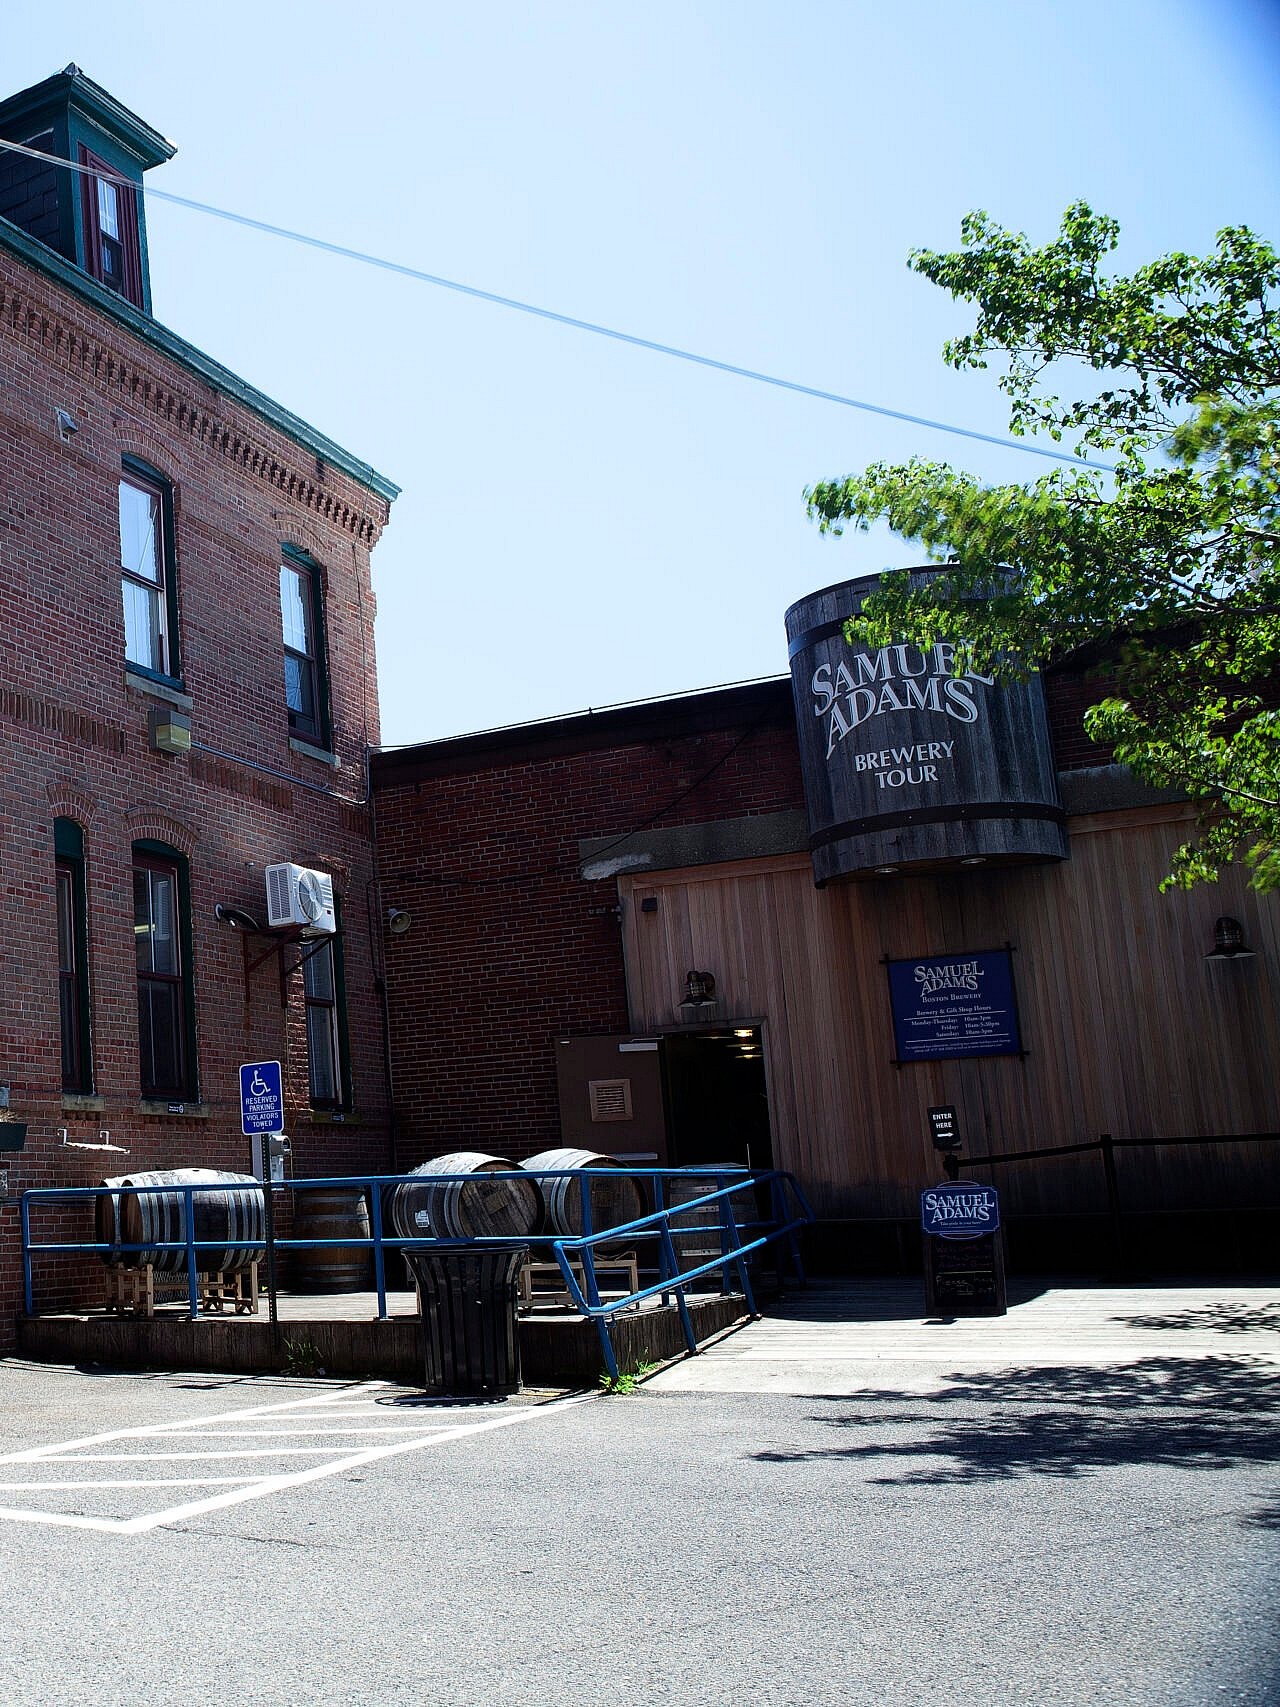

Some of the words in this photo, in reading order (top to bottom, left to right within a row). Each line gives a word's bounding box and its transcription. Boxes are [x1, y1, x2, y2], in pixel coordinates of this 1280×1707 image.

[825, 676, 979, 761] ADAMS
[855, 740, 955, 772] BREWERY
[875, 764, 938, 789] TOUR
[914, 961, 985, 982] SAMUEL
[920, 975, 978, 997] ADAMS
[245, 1095, 278, 1105] RESERVED
[249, 1103, 275, 1112] PARKING
[246, 1112, 279, 1121] VIOLATORS
[925, 1192, 995, 1210] SAMUEL
[931, 1206, 990, 1224] ADAMS
